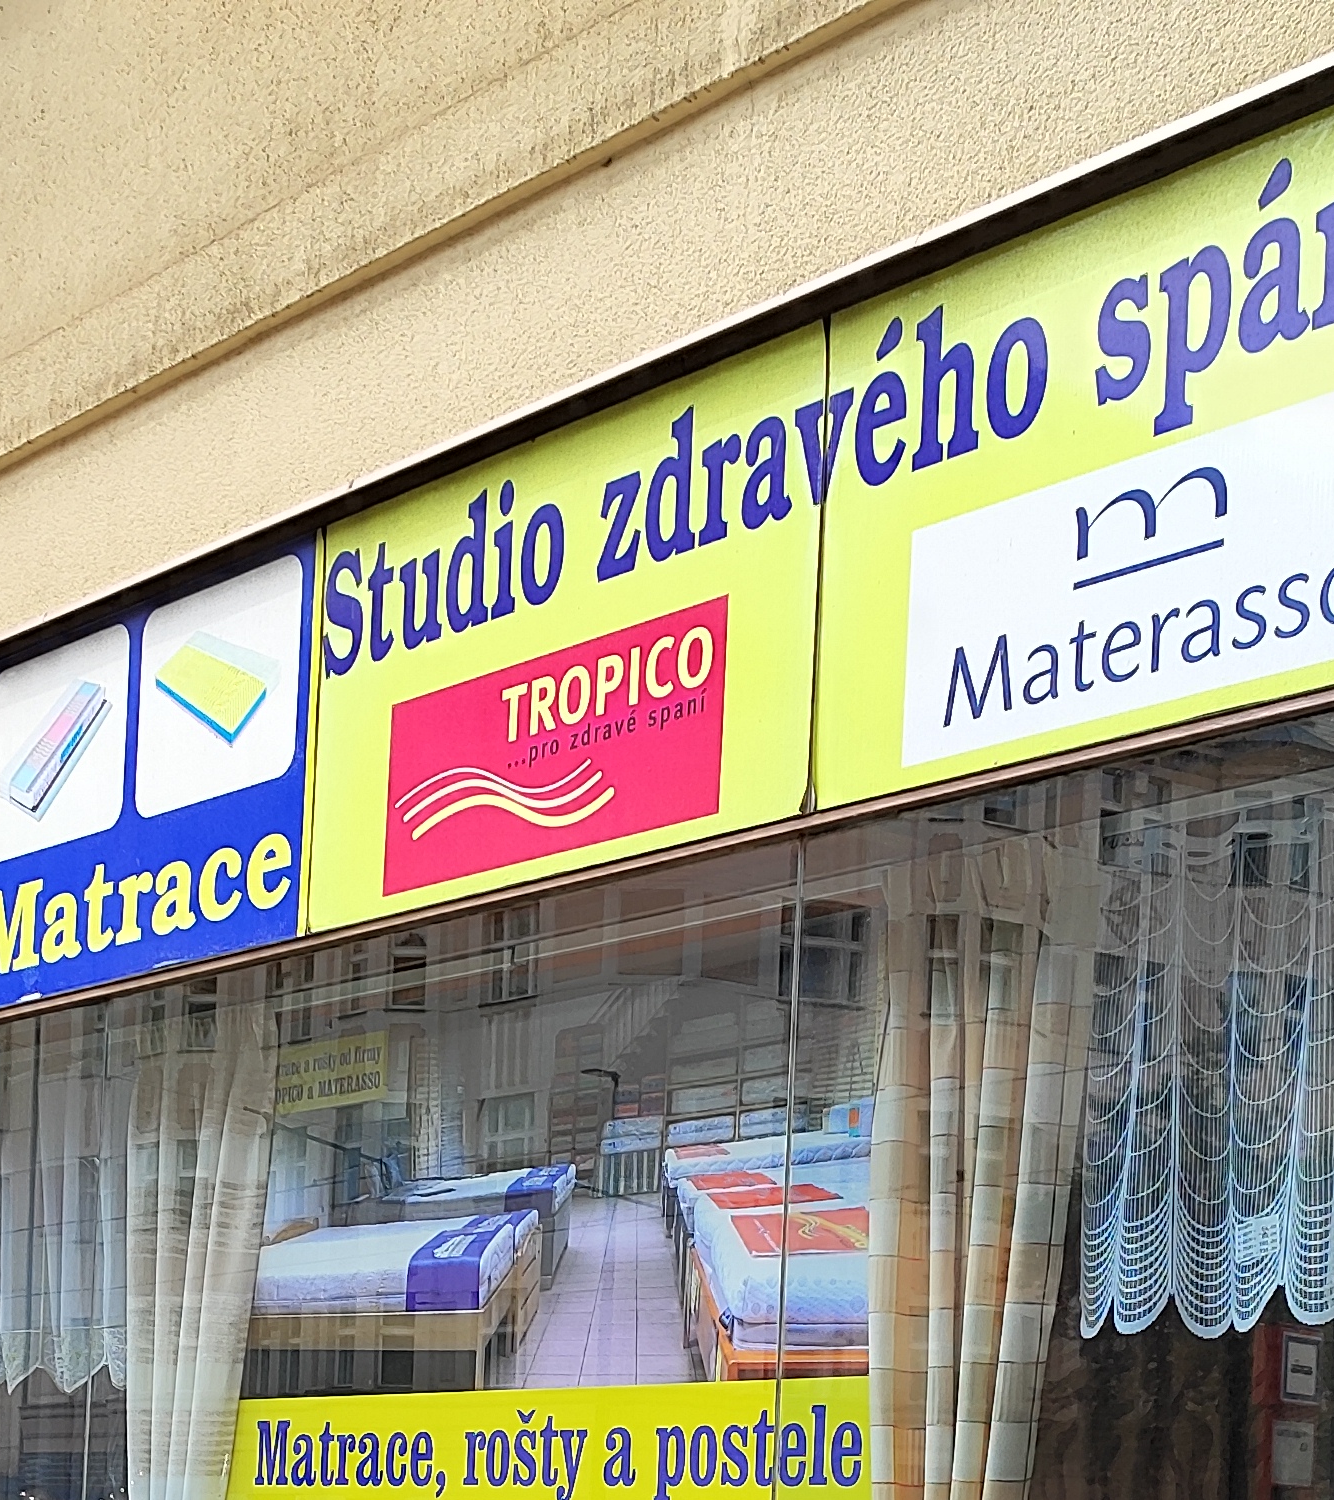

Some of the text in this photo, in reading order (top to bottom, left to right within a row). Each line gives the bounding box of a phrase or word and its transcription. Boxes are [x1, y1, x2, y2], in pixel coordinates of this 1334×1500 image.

[324, 479, 565, 680] Studio
[597, 303, 1049, 582] zdravého
[502, 625, 714, 743] TROPICO
[569, 708, 637, 751] zdravé
[648, 688, 707, 731] spaní
[317, 1070, 381, 1098] MATERASSO
[340, 1047, 352, 1067] od
[355, 1045, 382, 1065] firmy
[253, 1419, 447, 1498] Matrace,
[604, 1426, 637, 1488] a
